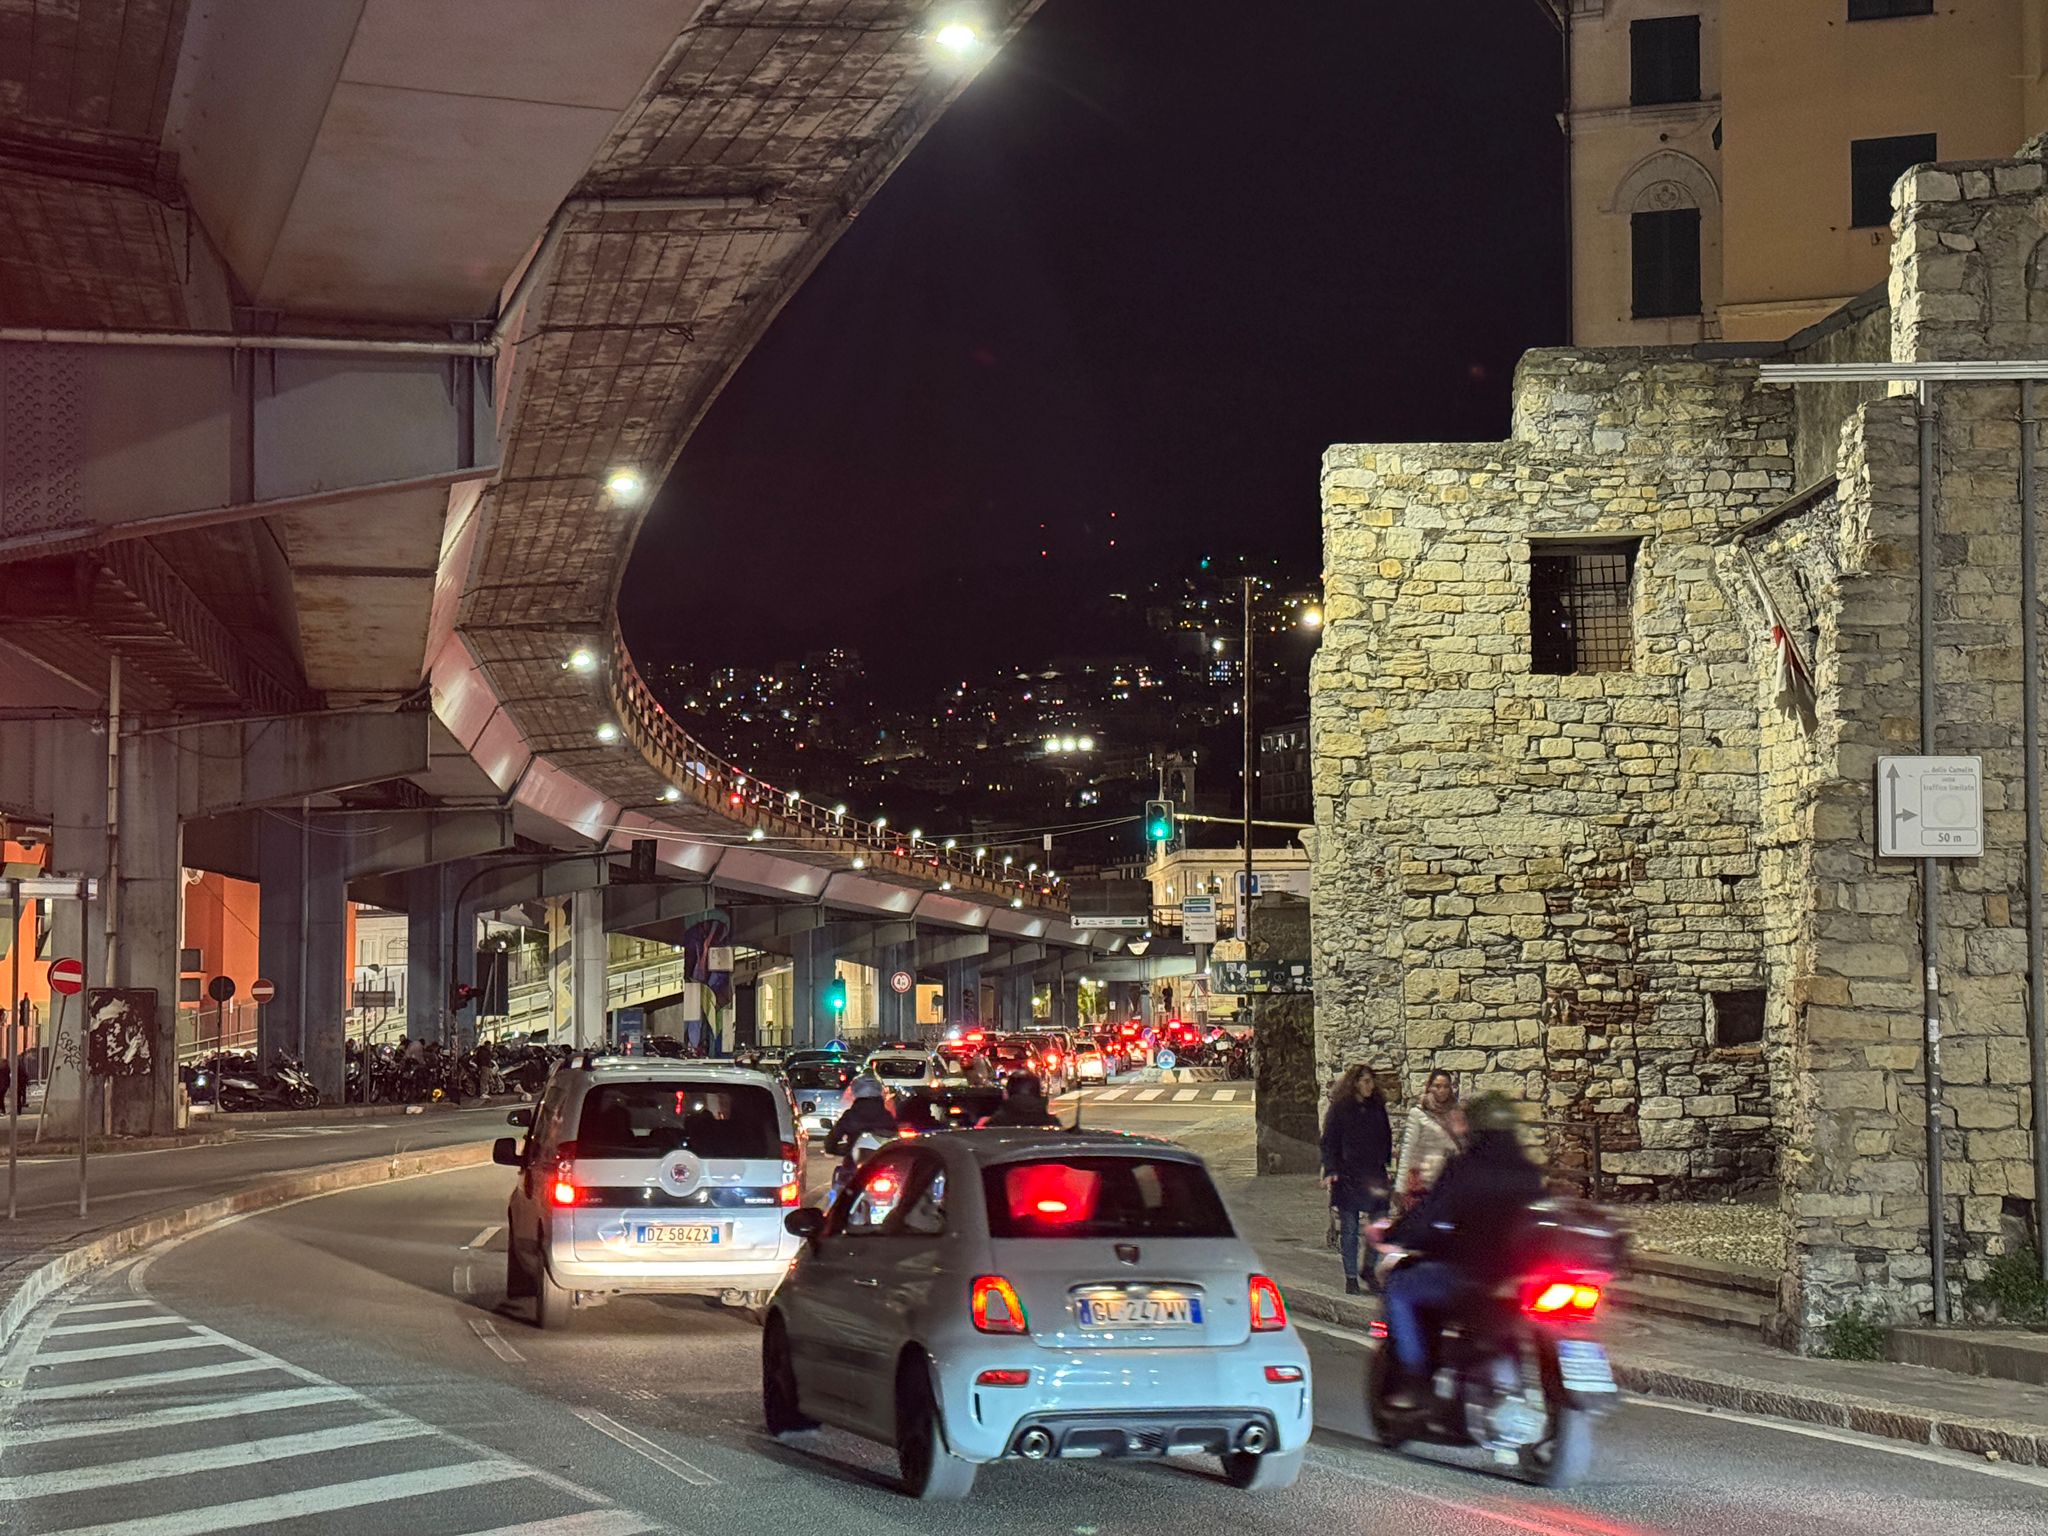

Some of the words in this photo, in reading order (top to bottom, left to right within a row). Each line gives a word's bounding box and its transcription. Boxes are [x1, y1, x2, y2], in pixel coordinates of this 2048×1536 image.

[1938, 832, 1950, 842] 50
[1953, 834, 1962, 842] m
[647, 1228, 664, 1241] DZ
[669, 1228, 709, 1241] 584ZX
